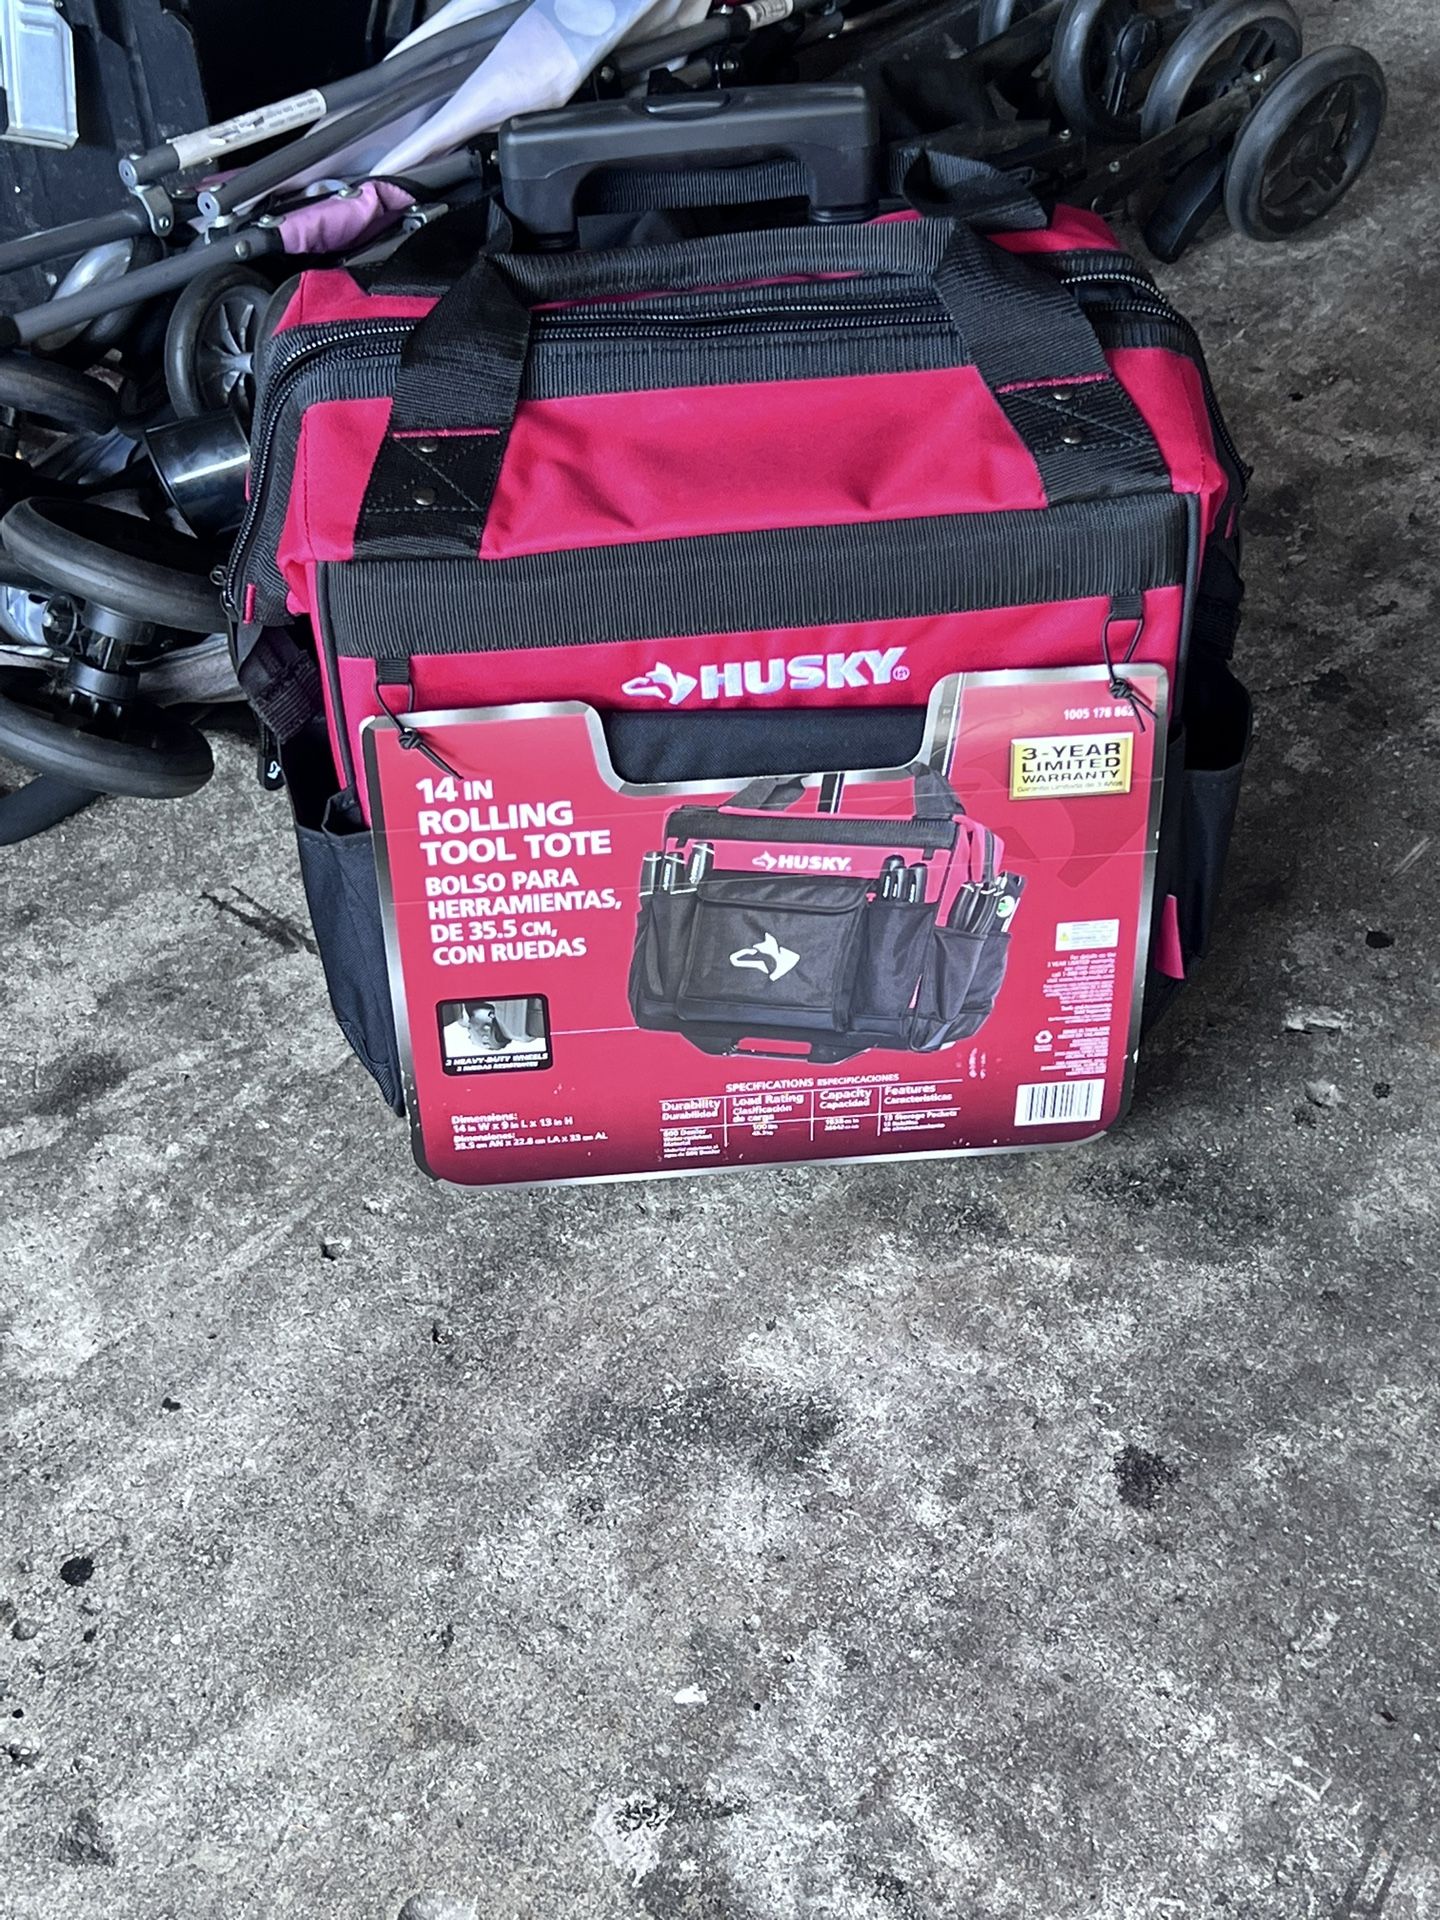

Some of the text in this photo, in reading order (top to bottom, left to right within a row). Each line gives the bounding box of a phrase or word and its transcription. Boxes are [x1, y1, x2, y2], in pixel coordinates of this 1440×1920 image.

[700, 646, 907, 700] HUSKY
[1064, 708, 1089, 720] 1005
[1093, 706, 1111, 719] 178
[1021, 742, 1121, 761] 3-YEAR
[1021, 757, 1121, 773] LIMITED
[1021, 769, 1120, 784] WARRANTY
[416, 777, 493, 804] 14 IN
[418, 800, 574, 836] ROLLING
[419, 829, 612, 866] TOOL TOTE
[777, 855, 848, 871] HUSKY
[424, 868, 579, 897] BOLSO PARA
[427, 888, 622, 920] HERRAMIENTAS,
[430, 919, 558, 943] DE 35.5 CM,
[432, 937, 587, 967] CON RUEDAS
[453, 1055, 511, 1065] HEAVY-DUTY
[512, 1052, 548, 1061] WHEELS
[726, 1078, 813, 1092] SPECIFICATIONS
[884, 1085, 936, 1096] Features
[733, 1092, 804, 1107] Load Rating
[820, 1088, 872, 1101] Capacity
[661, 1100, 721, 1112] Durability
[451, 1112, 518, 1124] Dimensions:
[453, 1124, 467, 1133] 14
[477, 1123, 490, 1131] W
[520, 1120, 528, 1128] L
[564, 1116, 573, 1125] H
